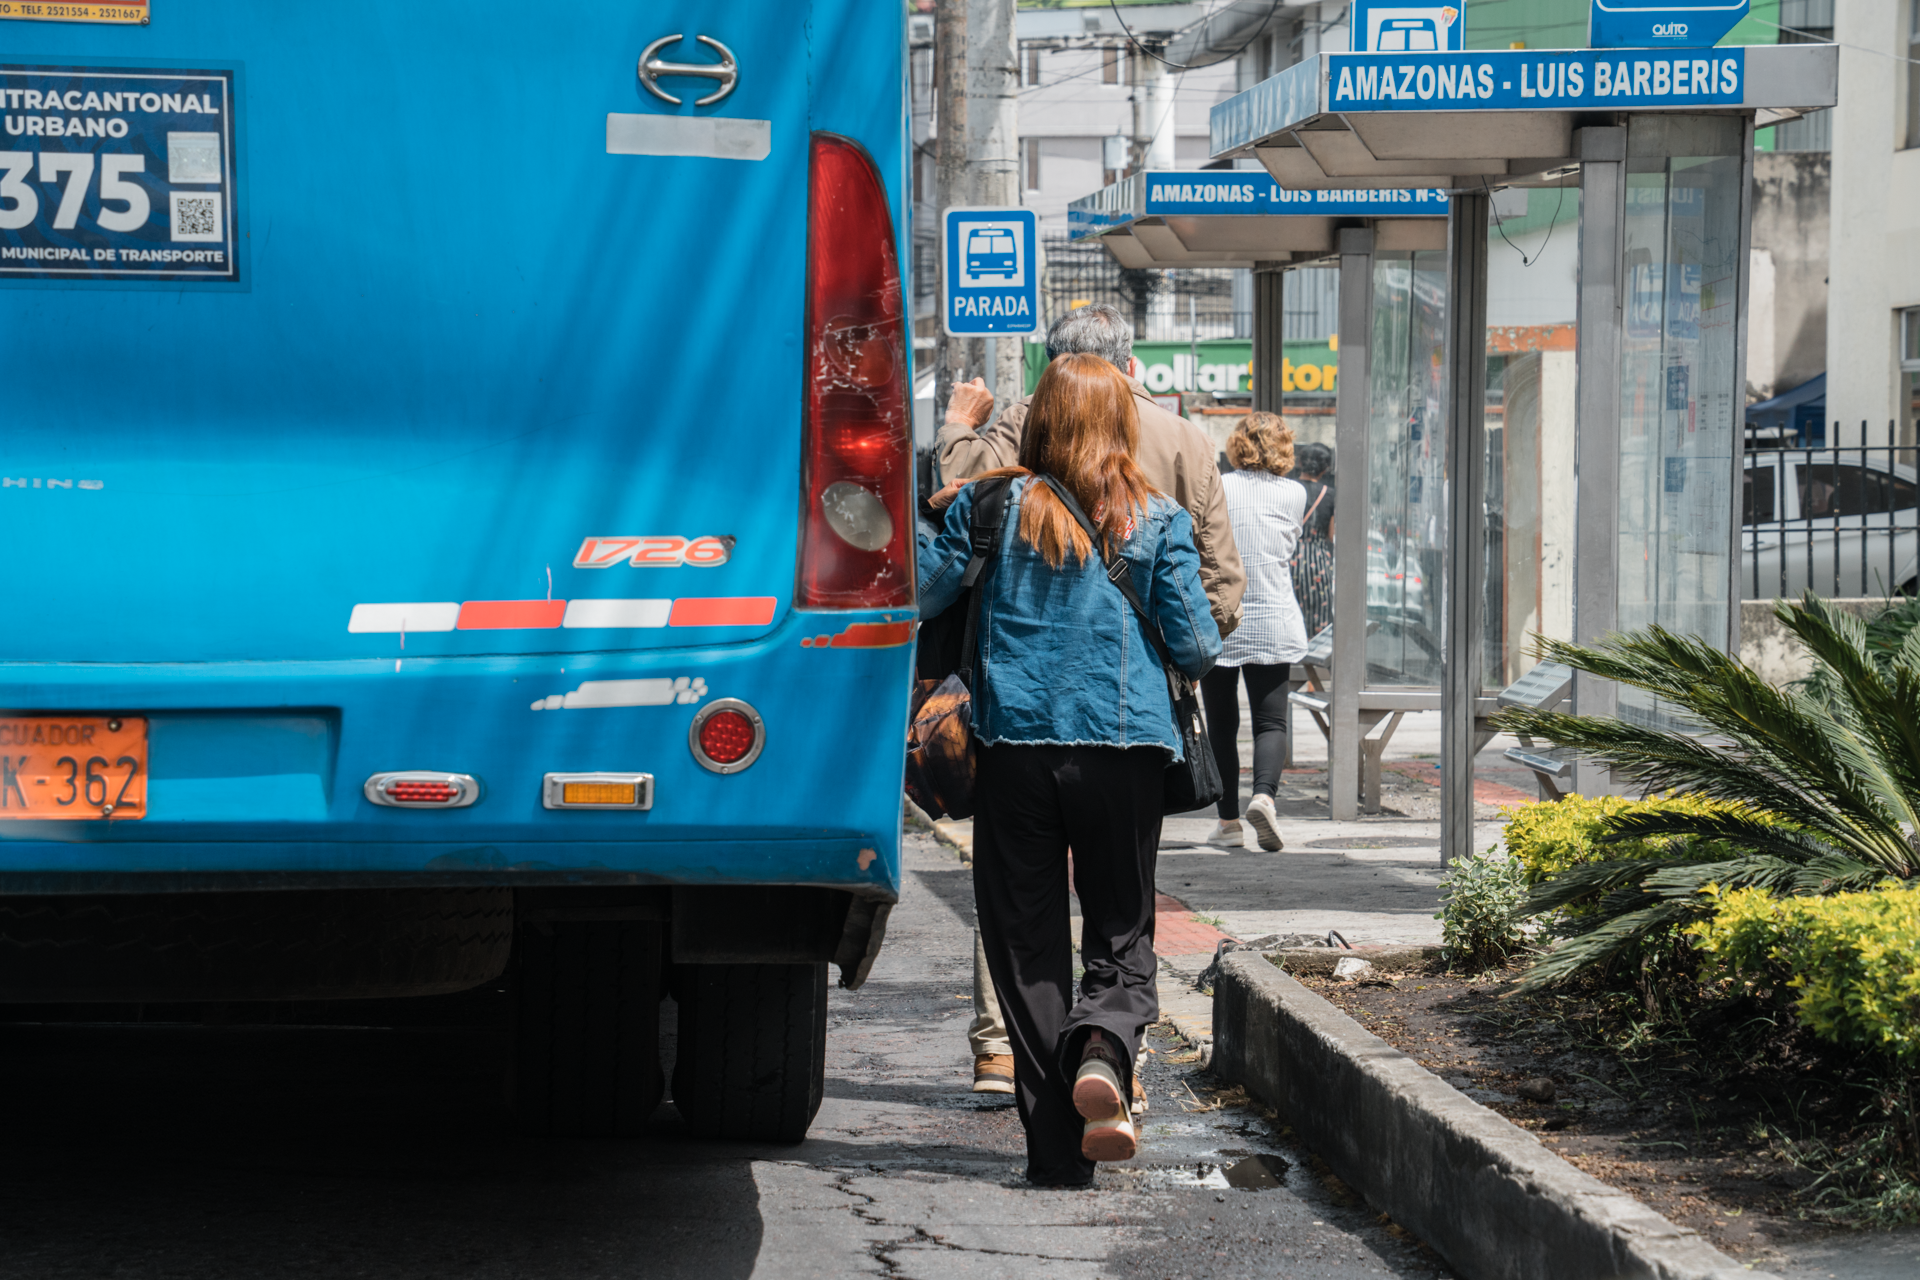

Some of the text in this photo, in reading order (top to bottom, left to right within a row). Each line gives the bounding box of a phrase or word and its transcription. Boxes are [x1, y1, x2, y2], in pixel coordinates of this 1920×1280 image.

[21, 5, 44, 15] TELF.
[47, 6, 89, 17] 2521554
[99, 8, 141, 19] 2521667
[1335, 64, 1494, 101] AMAZONAS
[1521, 62, 1584, 98] LUIS
[1594, 58, 1737, 97] BARBERIS
[5, 115, 129, 138] URBANO
[1150, 184, 1254, 203] AMAZONAS
[1270, 185, 1312, 202] LUIS
[1316, 189, 1411, 203] BARBERIS
[2, 246, 224, 263] MUNICIPAL DE TRANSPORTE
[954, 296, 1030, 317] PARADA
[573, 535, 732, 568] 1726
